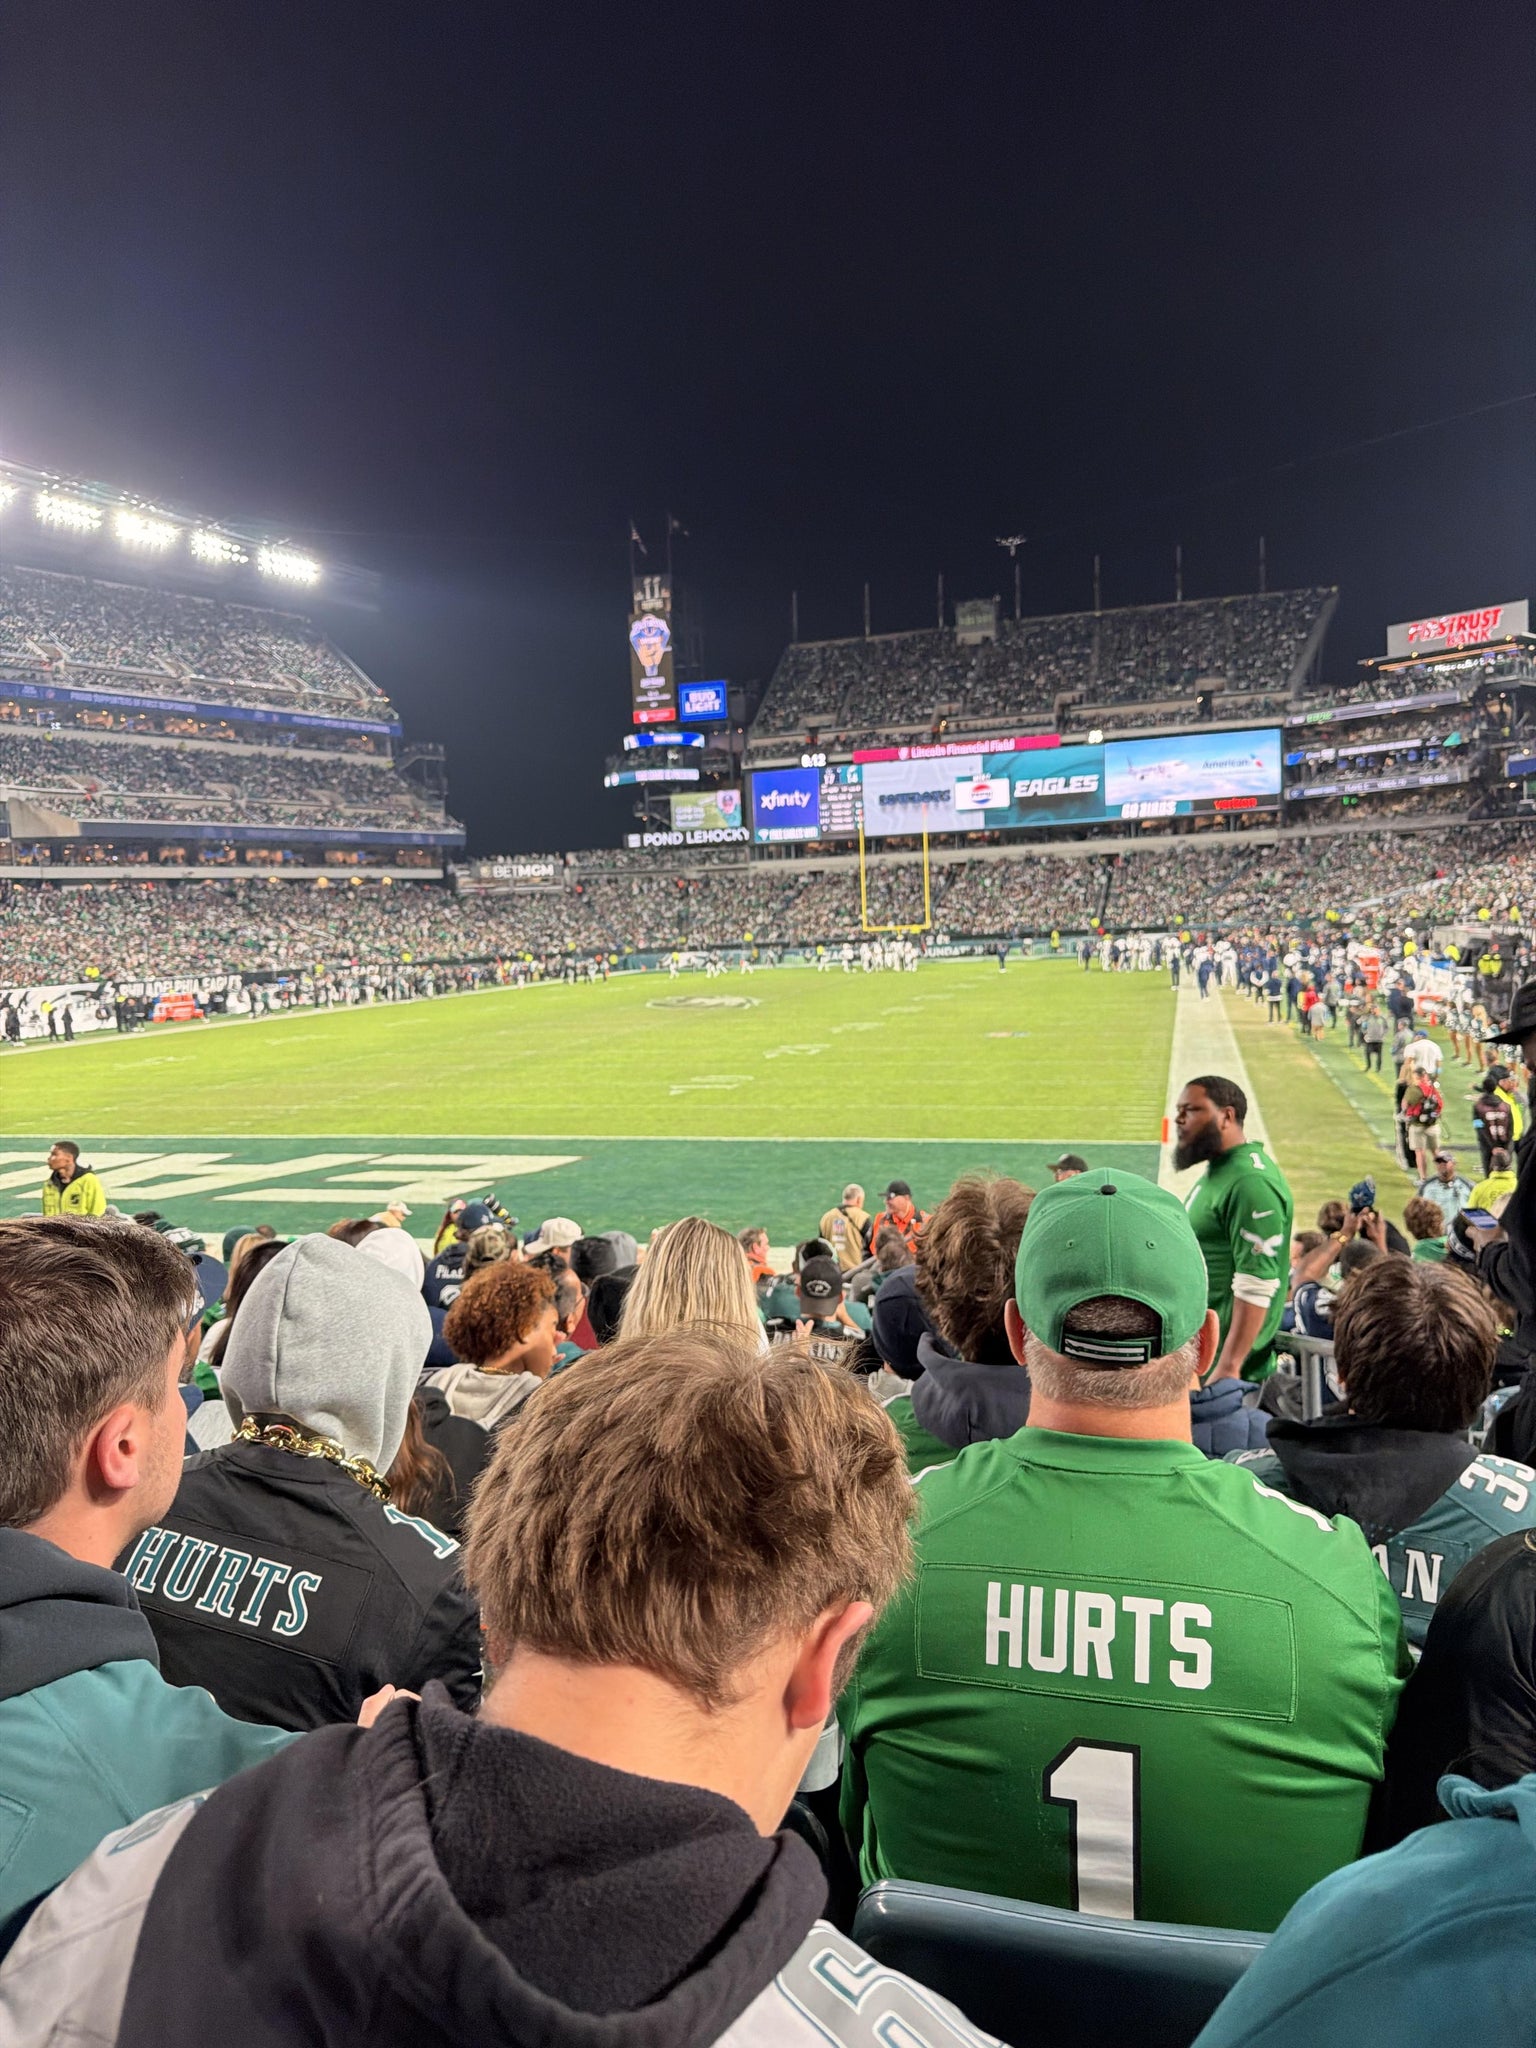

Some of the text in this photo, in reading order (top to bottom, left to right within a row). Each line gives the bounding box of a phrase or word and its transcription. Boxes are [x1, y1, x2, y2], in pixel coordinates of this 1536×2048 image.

[1446, 628, 1491, 647] BANK
[684, 699, 721, 713] LIGHT
[688, 690, 717, 703] BUD
[911, 738, 1015, 759] Lincoln Financial Field
[1202, 758, 1250, 769] American
[1014, 774, 1100, 798] EAGLES
[761, 790, 811, 810] xfinity
[1214, 797, 1258, 811] verizon
[1121, 802, 1139, 819] GO
[643, 827, 750, 847] POND LEHOCKY
[493, 864, 554, 878] BETMGM
[119, 979, 199, 998] PHILADELPHIA
[1249, 1152, 1266, 1170] 1
[383, 1504, 461, 1560] 1
[123, 1526, 322, 1636] HURTS
[985, 1581, 1212, 1690] HURTS
[1042, 1737, 1141, 1920] 1
